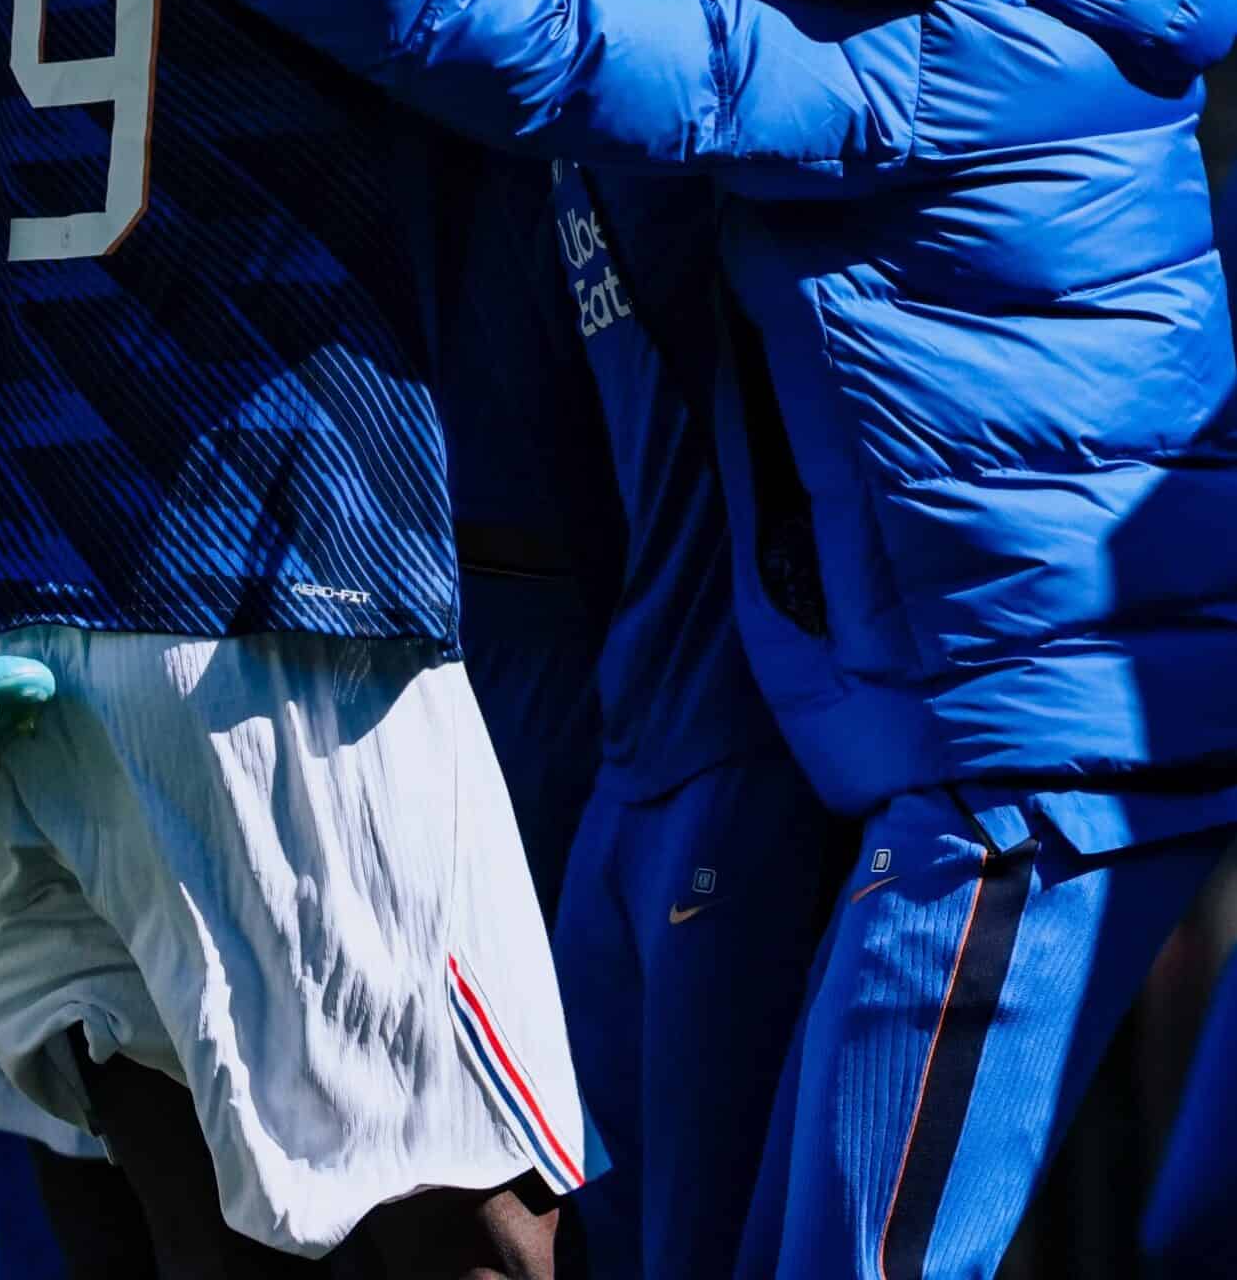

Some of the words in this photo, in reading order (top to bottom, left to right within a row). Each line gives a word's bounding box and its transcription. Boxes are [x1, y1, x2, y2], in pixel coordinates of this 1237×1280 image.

[557, 207, 609, 270] Ube
[574, 266, 632, 337] Eat
[291, 583, 372, 604] AERO-FIT
